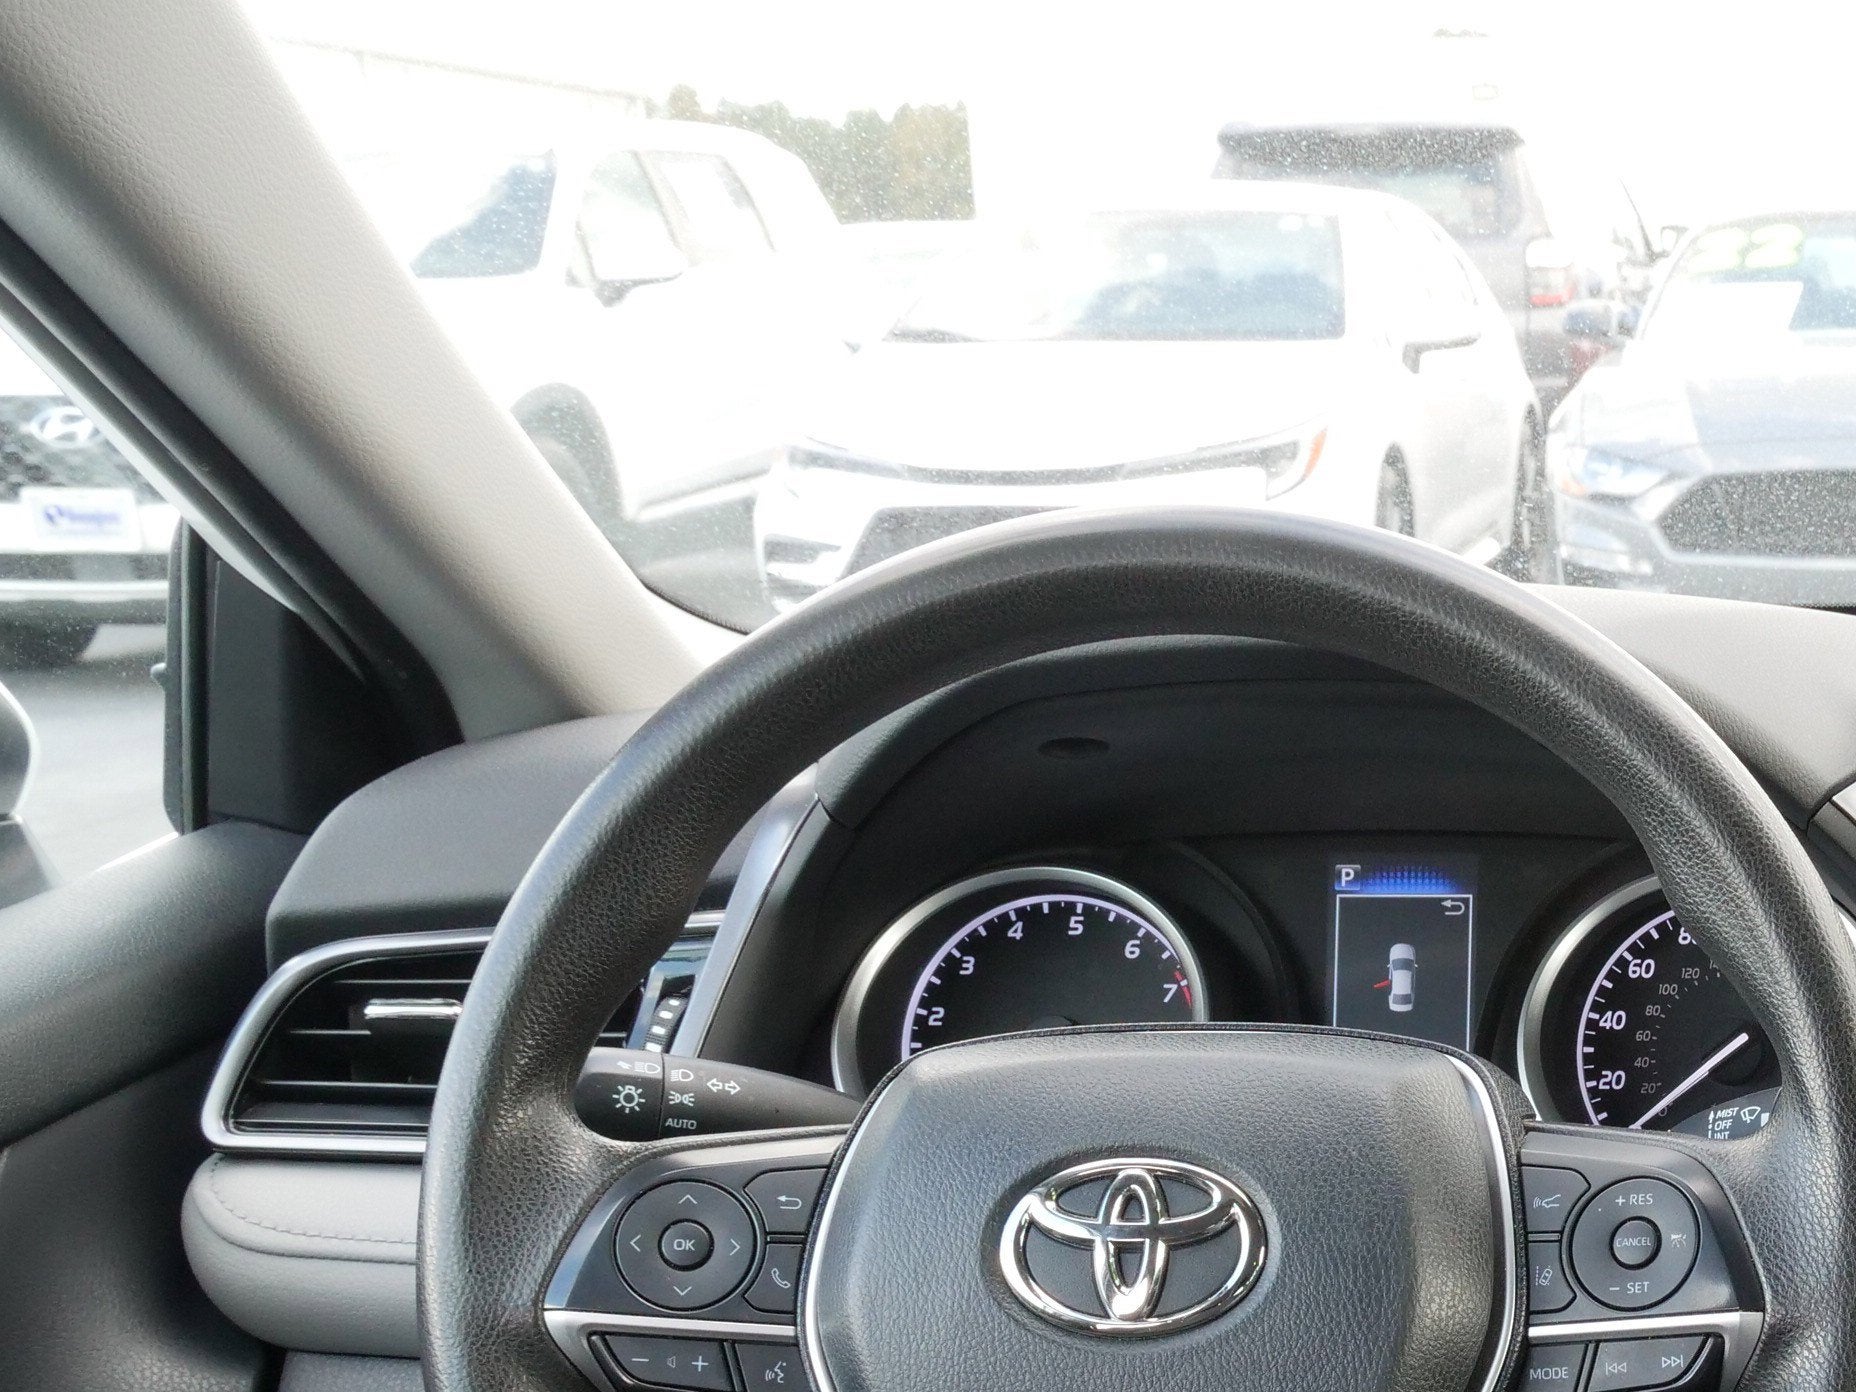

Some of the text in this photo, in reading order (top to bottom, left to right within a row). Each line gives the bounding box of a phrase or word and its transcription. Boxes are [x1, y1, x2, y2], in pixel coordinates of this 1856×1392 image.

[1341, 868, 1355, 887] P
[1007, 921, 1023, 940] 4
[1068, 916, 1084, 935] 5
[1124, 939, 1140, 959] 6
[959, 956, 975, 975] 3
[1628, 959, 1655, 979] 60
[1681, 968, 1700, 979] 120
[1163, 983, 1178, 1003] 7
[1658, 984, 1678, 995] 100
[928, 1007, 945, 1026] 2
[1645, 1005, 1661, 1016] 80
[1599, 1010, 1627, 1030] 40
[1636, 1031, 1651, 1041] 60
[1634, 1057, 1650, 1067] 40
[1598, 1070, 1626, 1090] 20
[1640, 1083, 1656, 1093] 20
[1716, 1107, 1739, 1119] MIST
[665, 1118, 697, 1130] AUTO
[1714, 1119, 1733, 1131] OFF
[1714, 1131, 1729, 1139] INT
[1630, 1194, 1653, 1205] RES
[673, 1239, 695, 1251] OK
[1616, 1237, 1652, 1247] CANCEL
[1627, 1282, 1650, 1293] SET
[1529, 1367, 1569, 1380] MODE
